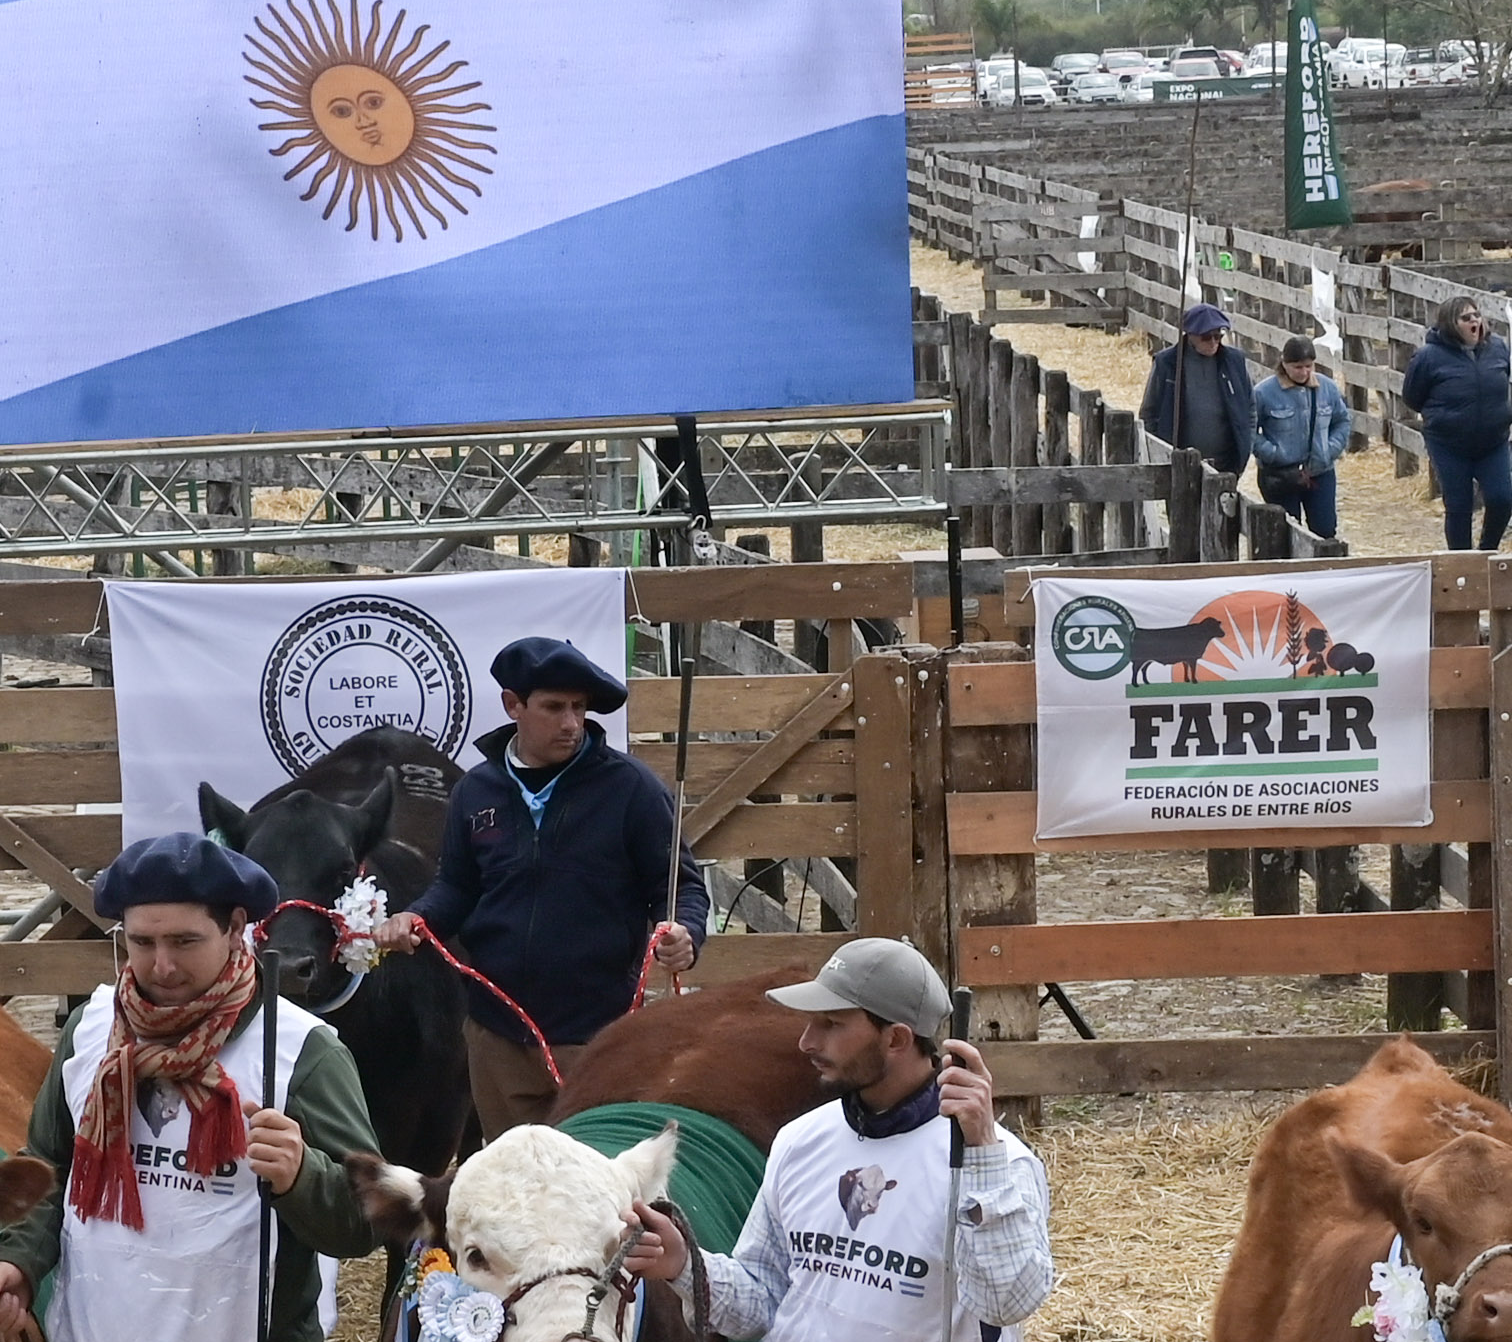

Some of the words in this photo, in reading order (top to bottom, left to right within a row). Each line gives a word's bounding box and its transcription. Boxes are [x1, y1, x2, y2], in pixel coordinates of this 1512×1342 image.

[284, 623, 372, 699] SOCIEDAD
[385, 628, 443, 695] RURAL
[330, 675, 398, 691] LABORE
[354, 696, 375, 709] ET
[317, 713, 414, 729] COSTANTIA
[1129, 695, 1377, 760] FARER
[1124, 780, 1226, 801] FEDERACIÓN
[1233, 783, 1254, 798] DE
[1258, 779, 1380, 797] ASOCIACIONES
[1151, 804, 1227, 820] RURALES
[1231, 803, 1253, 818] DE
[1257, 801, 1310, 817] ENTRE
[1314, 797, 1353, 816] RÍOS
[789, 1231, 929, 1280] HEREFORD
